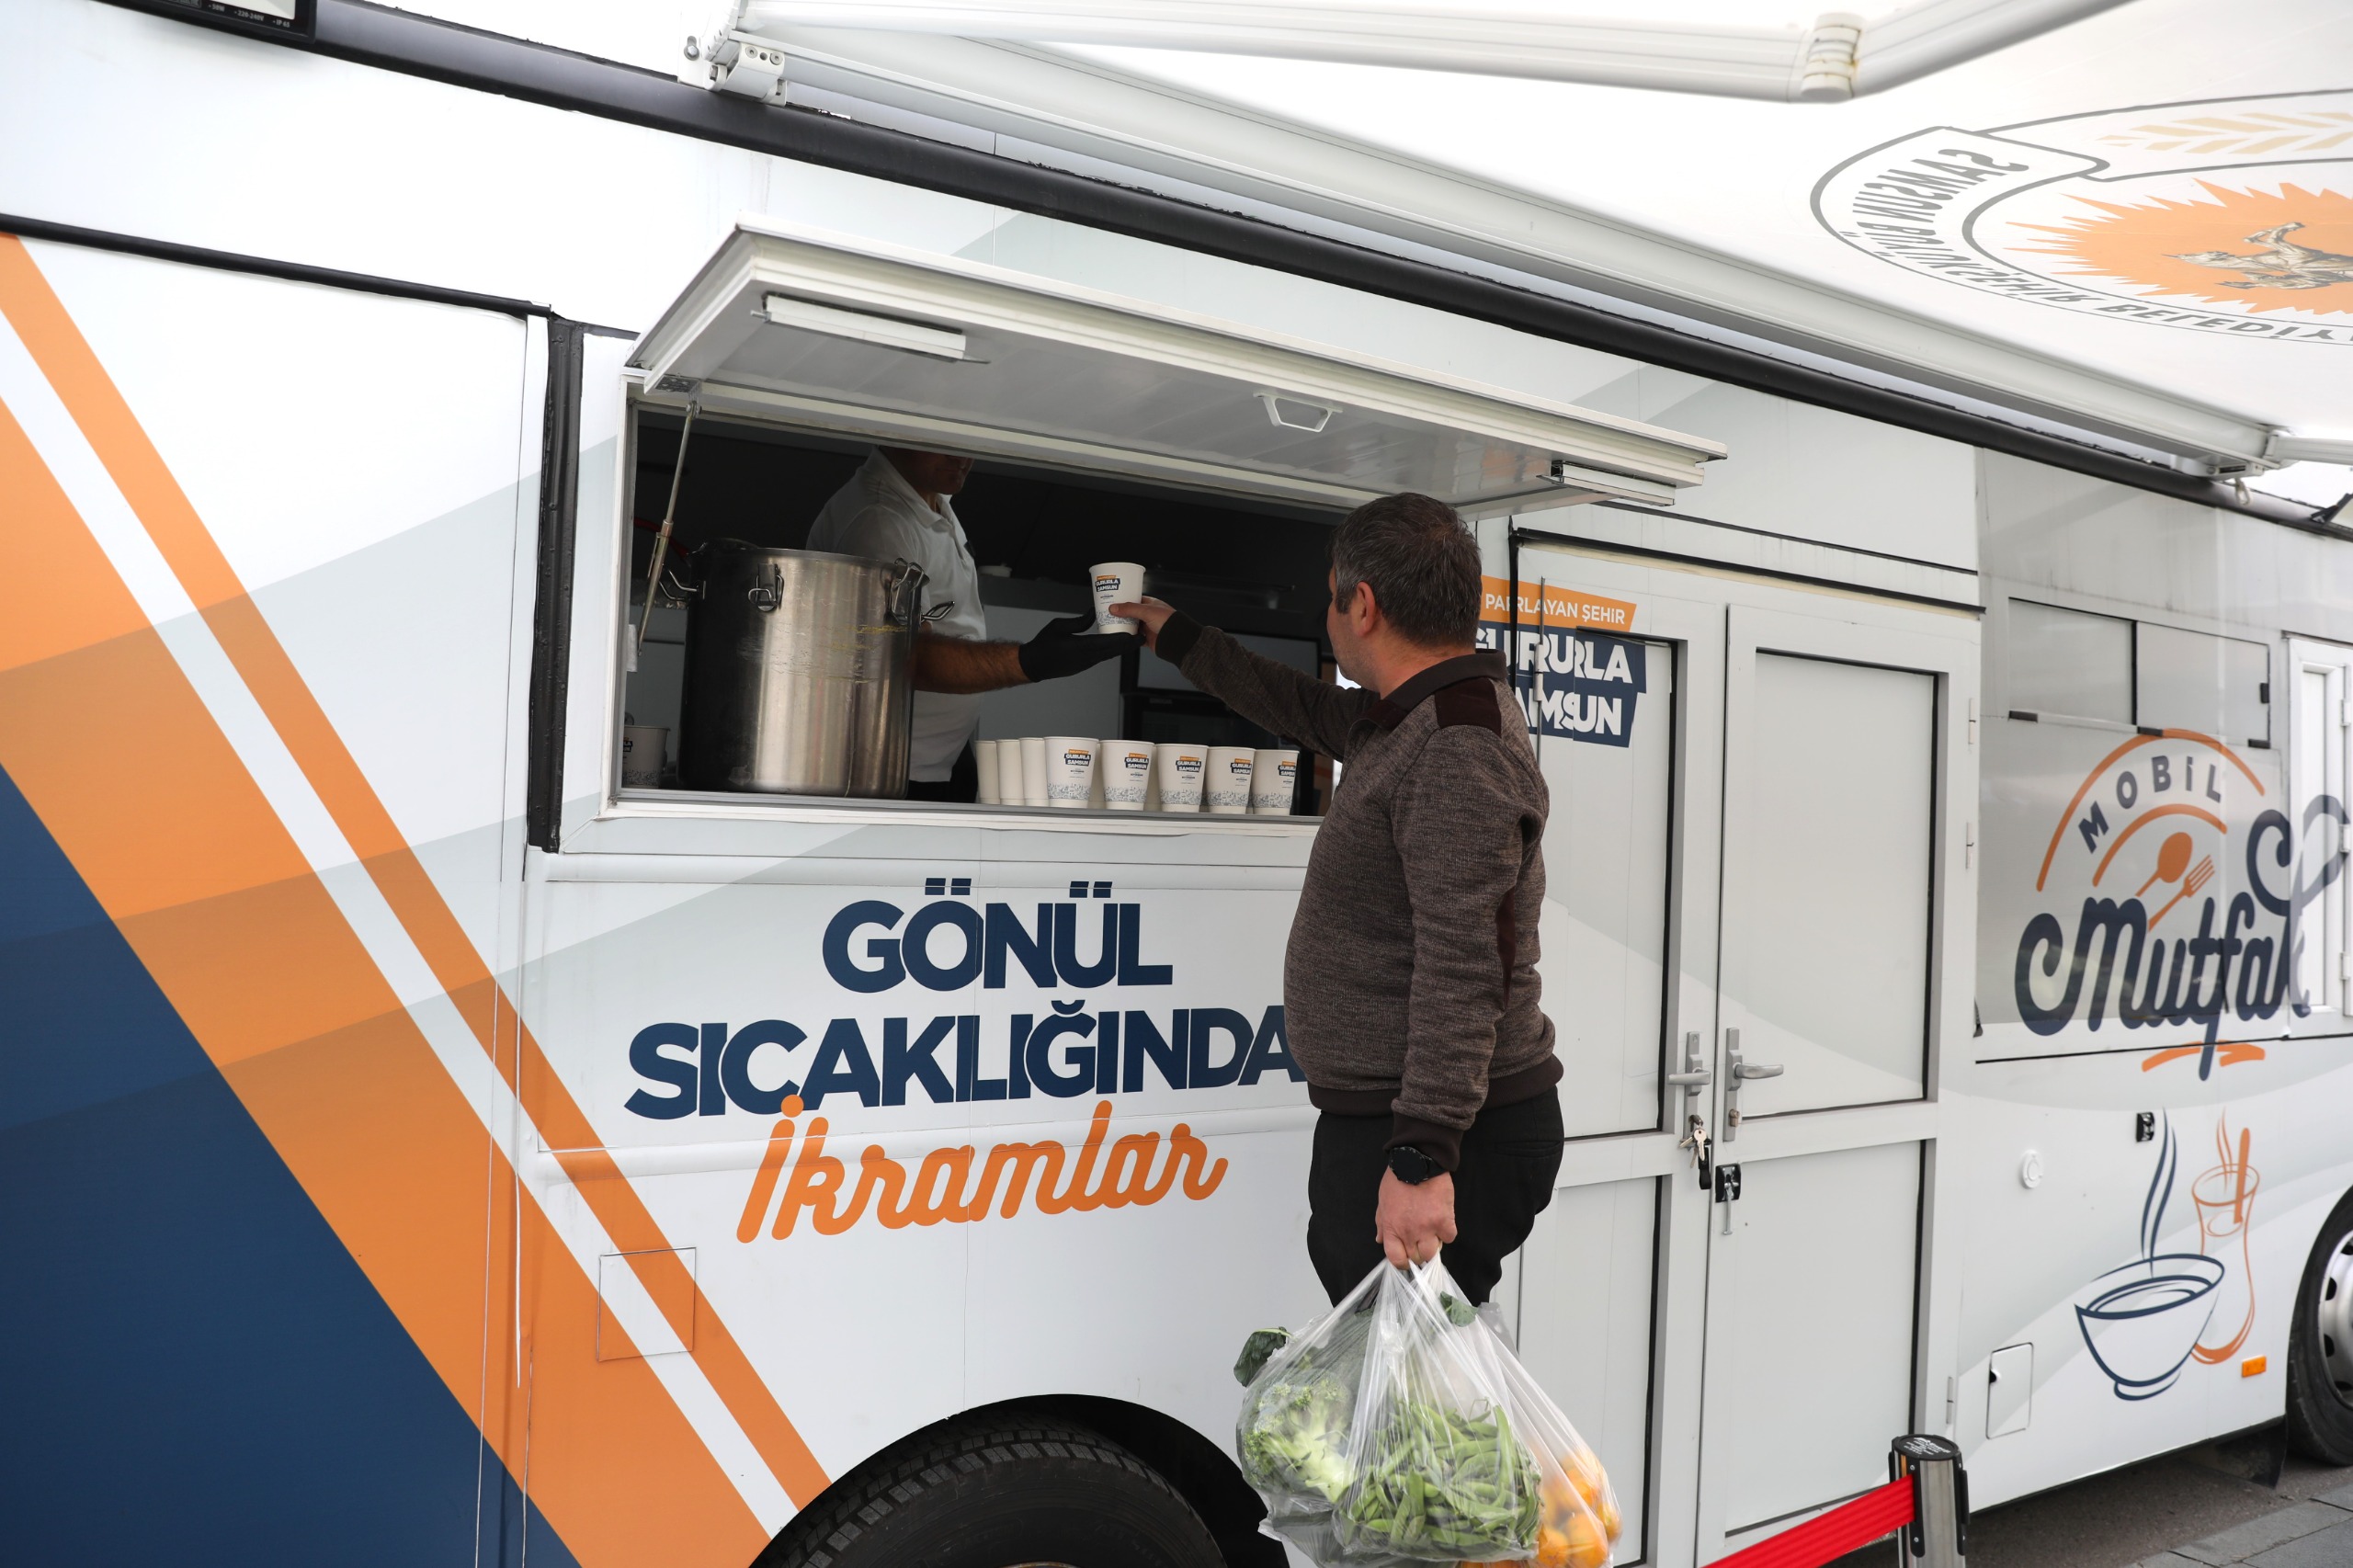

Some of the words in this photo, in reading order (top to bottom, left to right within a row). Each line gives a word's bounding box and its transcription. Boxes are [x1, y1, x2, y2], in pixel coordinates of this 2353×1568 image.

[1485, 593, 1578, 619] PARLAYAN
[1582, 603, 1625, 625] ŞEHİR
[2078, 755, 2222, 854] MOBİL
[822, 877, 1174, 994] GÖNÜL
[2014, 794, 2350, 1082] Mutfak
[623, 998, 1309, 1121] SICAKLIĞINDA
[735, 1093, 1229, 1244] İkramlar
